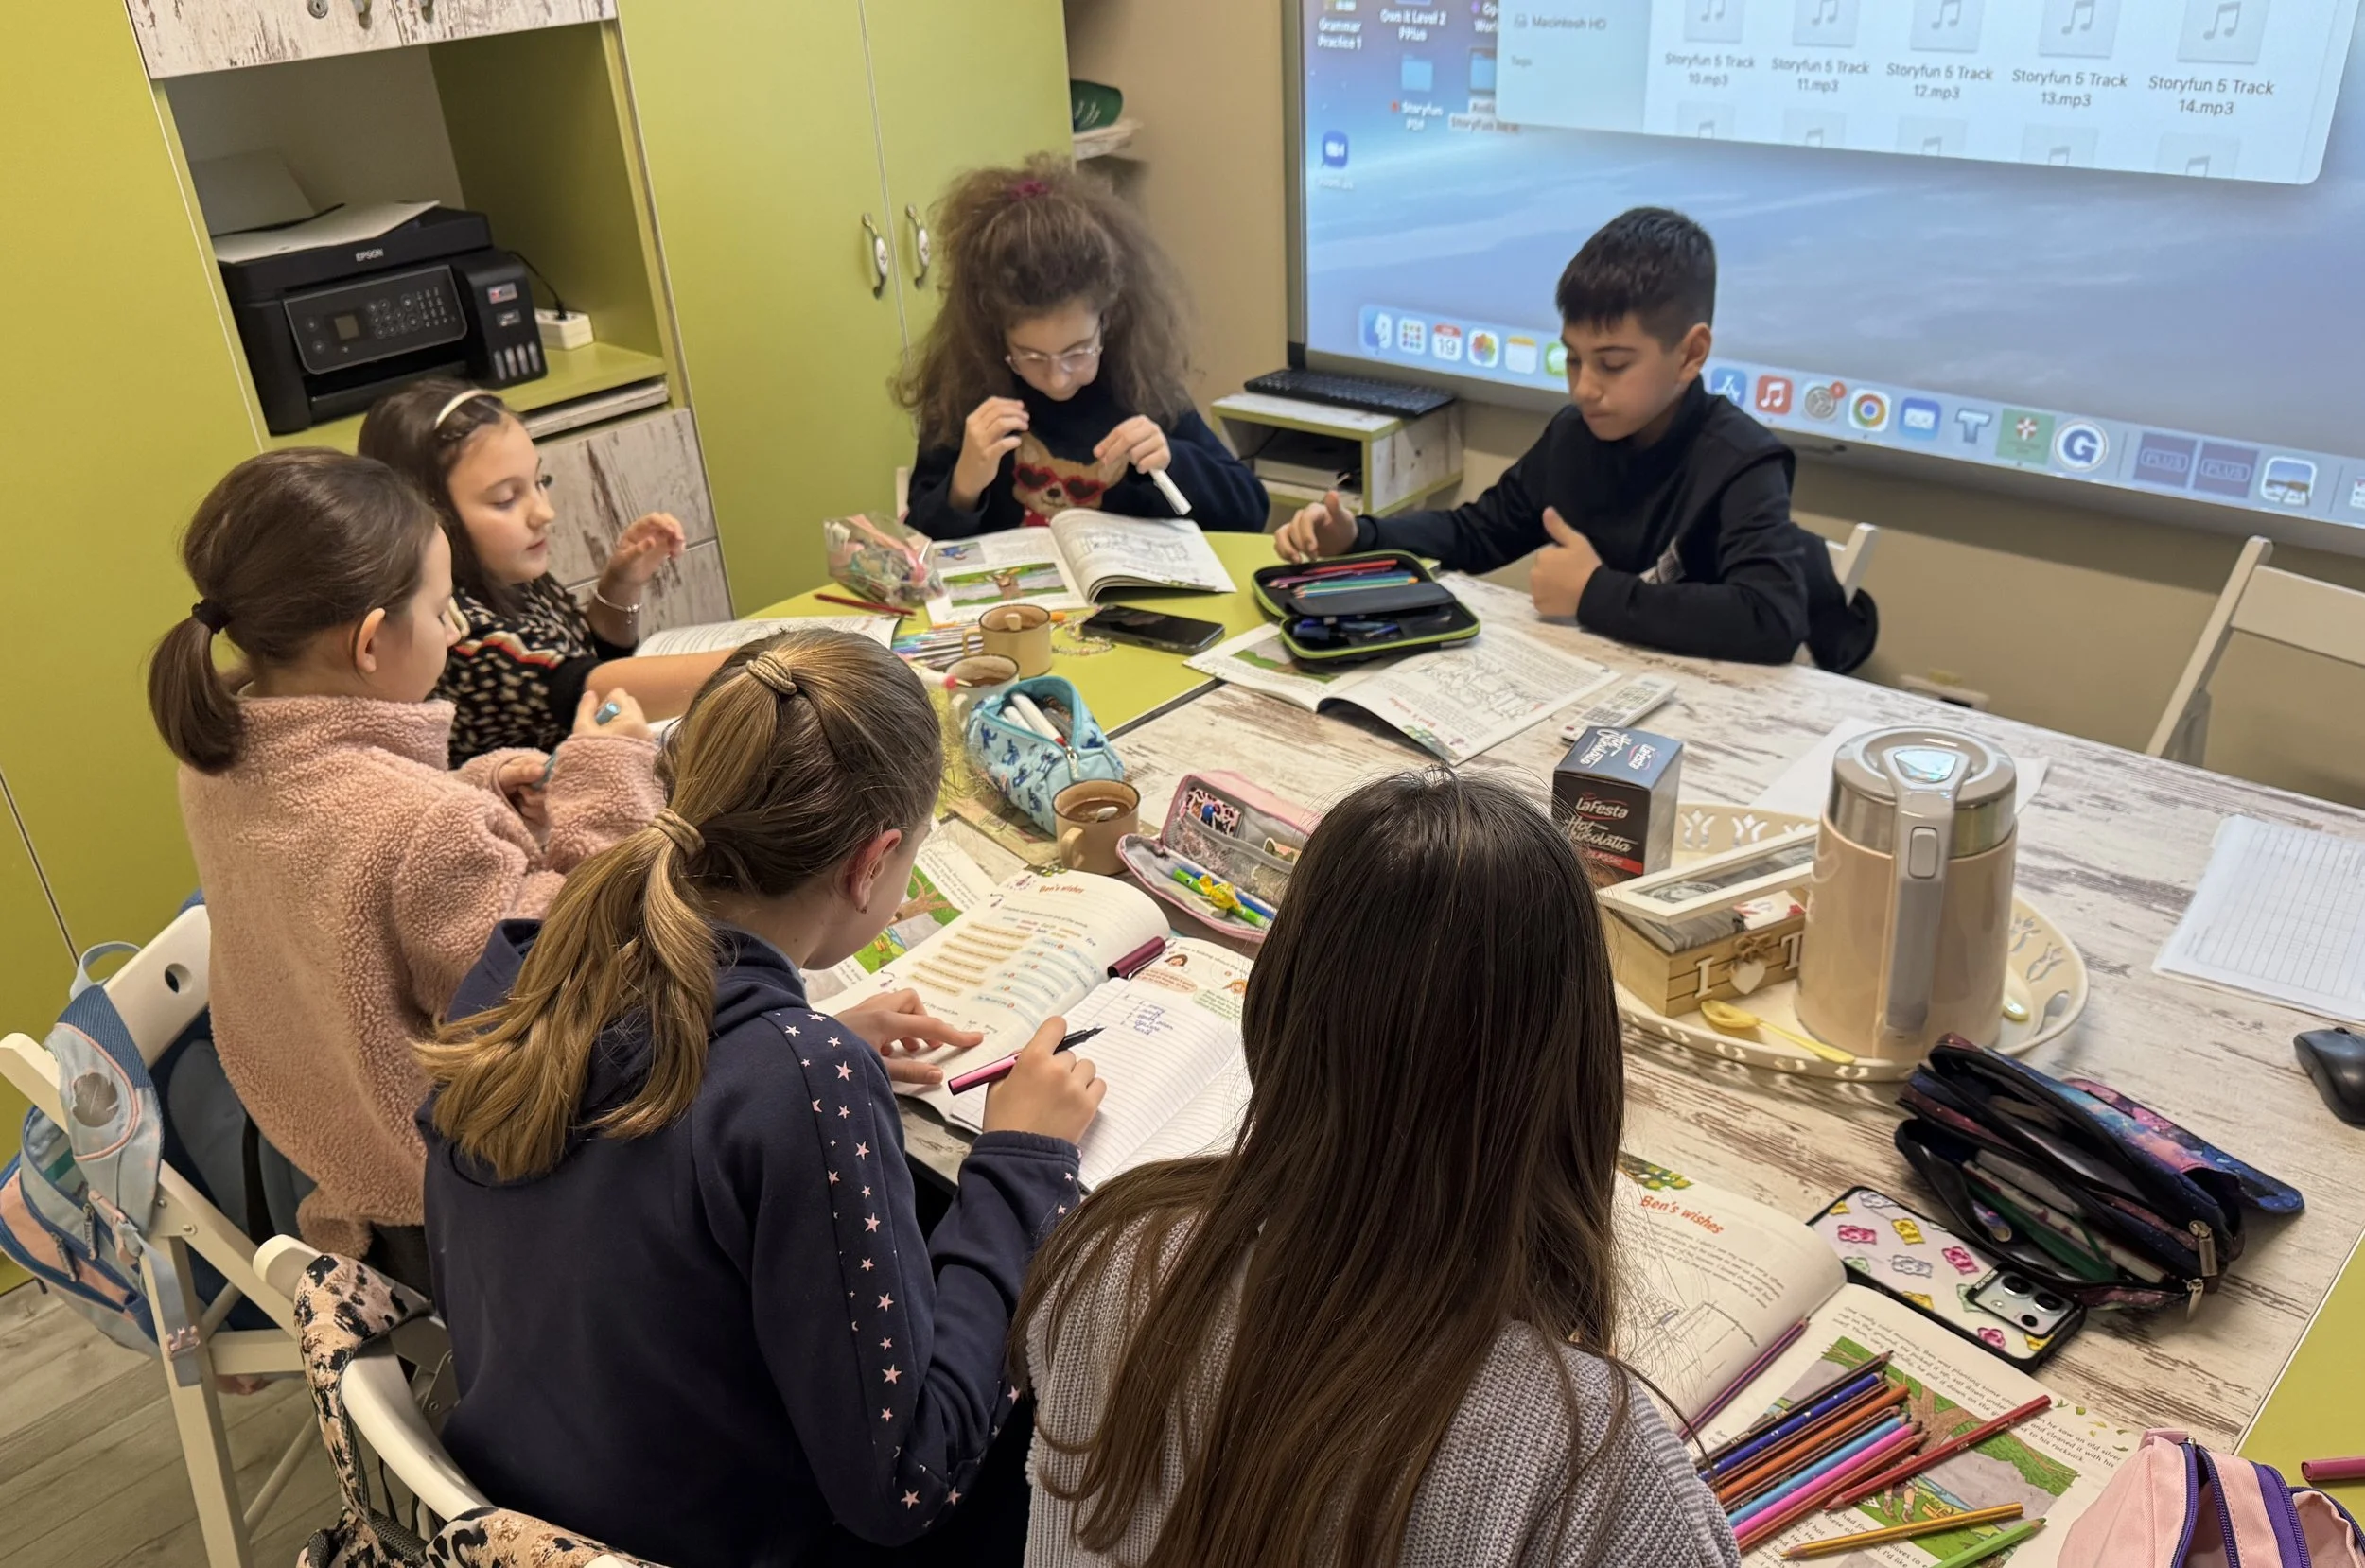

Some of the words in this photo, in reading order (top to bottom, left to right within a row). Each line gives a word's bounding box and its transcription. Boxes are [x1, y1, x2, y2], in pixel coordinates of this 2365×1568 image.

[1318, 18, 1361, 33] Grammar
[1411, 10, 1438, 25] Level
[1439, 10, 1446, 26] 2
[1533, 15, 1586, 30] Macintosh
[1589, 17, 1606, 31] HD
[1317, 33, 1356, 49] Practice
[1665, 52, 1712, 69] Storyfun
[1714, 55, 1723, 67] 5
[1726, 55, 1756, 69] Track
[1771, 57, 1822, 75] Storyfun
[1824, 61, 1832, 74] 5
[1837, 61, 1870, 75] Track
[1689, 72, 1729, 88] 10.mp3
[1886, 62, 1942, 80] Storyfun
[1944, 66, 1953, 79] 5
[1958, 66, 1994, 82] Track
[2011, 69, 2072, 88] Storyfun
[2075, 72, 2084, 86] 5
[2090, 73, 2128, 89] Track
[1797, 78, 1839, 94] 11.mp3
[1914, 84, 1961, 100] 12.mp3
[2148, 75, 2213, 94] Storyfun
[2217, 78, 2228, 94] 5
[2232, 78, 2276, 96] Track
[2041, 91, 2092, 108] 13.mp3
[2177, 99, 2234, 116] 14.mp3
[355, 248, 384, 262] EPSON
[1437, 338, 1457, 356] 19
[2062, 428, 2098, 464] G
[2145, 451, 2186, 471] PLUS
[2205, 462, 2247, 480] PLUS
[1575, 797, 1629, 819] LaFesta
[1640, 1194, 1679, 1214] Ben's
[1680, 1208, 1724, 1234] wishes
[1909, 1351, 1934, 1368] picked
[1953, 1377, 1965, 1386] sat
[1964, 1385, 1986, 1400] down
[1986, 1397, 2006, 1411] under
[2029, 1422, 2047, 1434] and
[2046, 1431, 2076, 1449] cleaned
[2084, 1450, 2102, 1462] with
[2103, 1458, 2114, 1469] his
[1916, 1364, 1926, 1373] he
[1925, 1371, 1940, 1382] put
[1946, 1384, 1967, 1398] down
[1967, 1396, 1977, 1404] on
[1977, 1402, 1991, 1411] the
[2039, 1435, 2051, 1446] his
[1950, 1368, 1981, 1388] planting
[1981, 1385, 2001, 1398] some
[2046, 1420, 2058, 1429] he
[2057, 1427, 2075, 1437] saw
[2086, 1442, 2101, 1452] old
[2100, 1449, 2122, 1462] silver
[1789, 1533, 1801, 1543] He
[1803, 1531, 1815, 1542] He
[1811, 1524, 1826, 1537] hot
[1841, 1512, 1856, 1524] had
[1911, 1556, 1921, 1565] to
[1894, 1557, 1908, 1568] like
